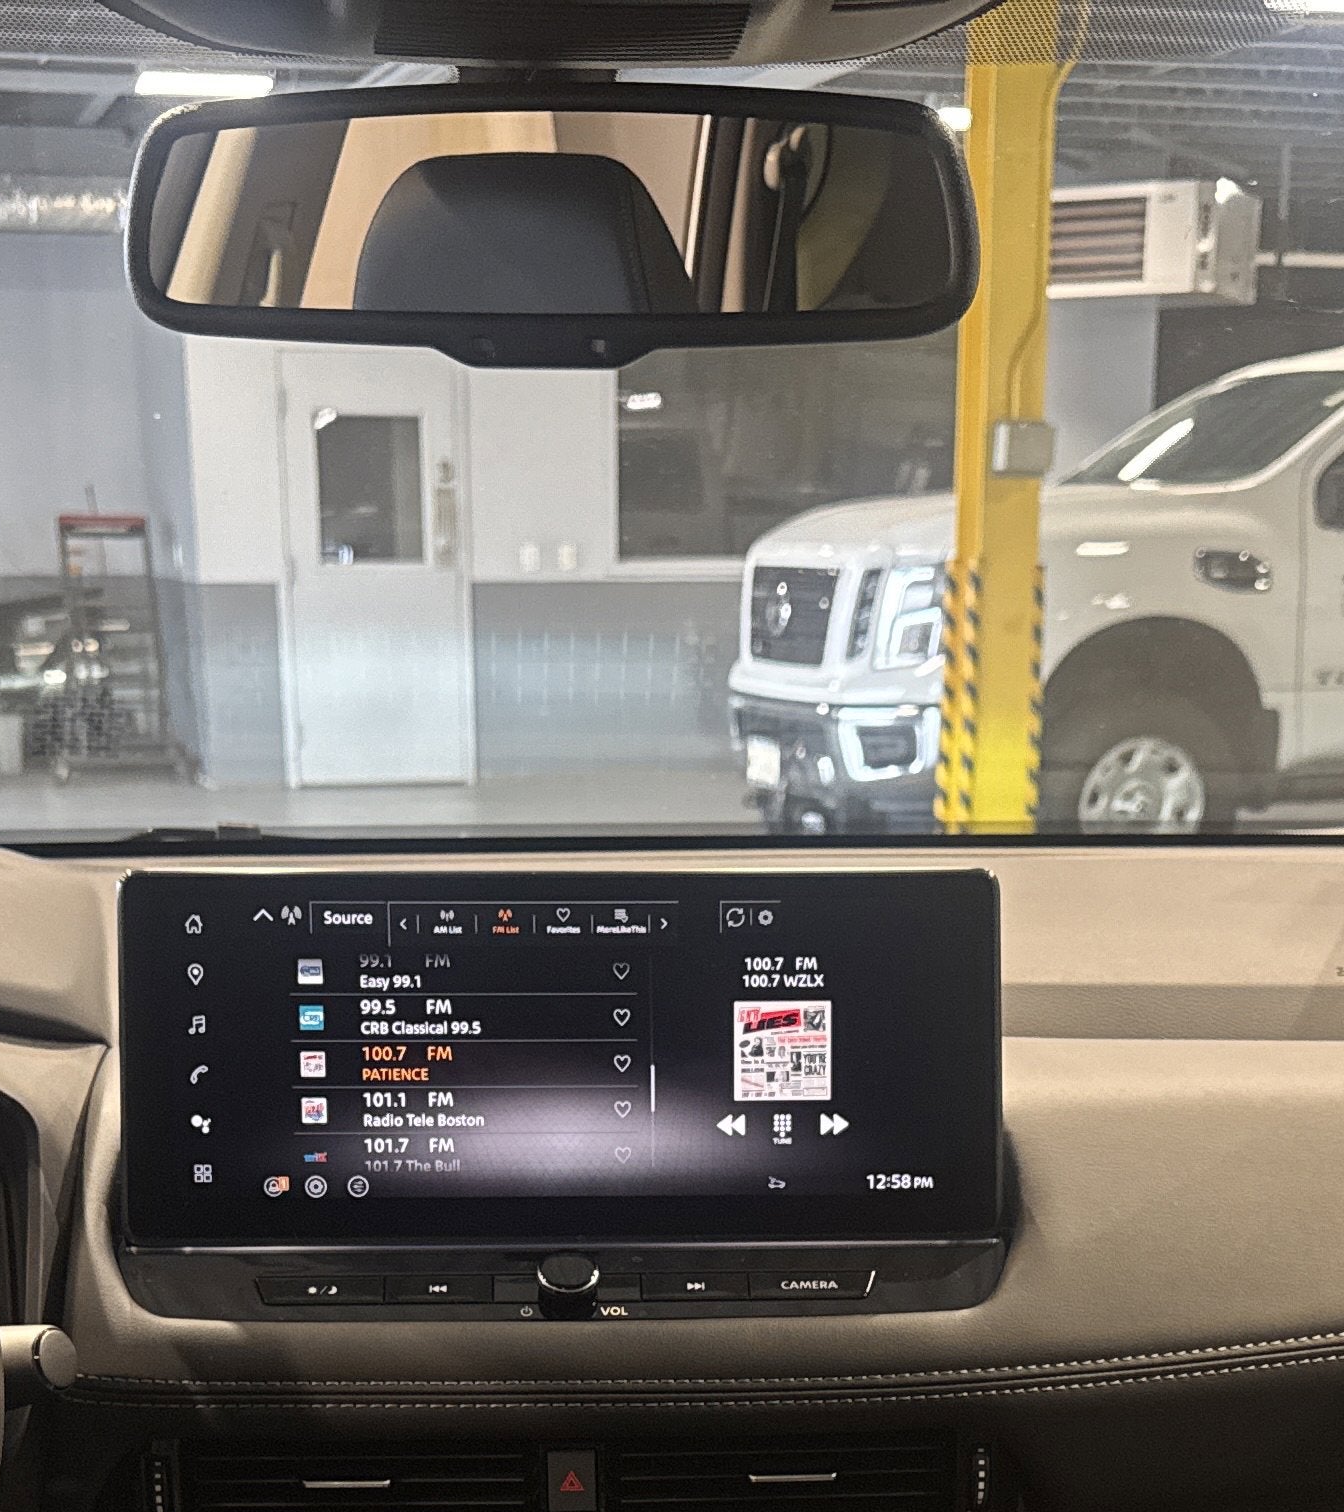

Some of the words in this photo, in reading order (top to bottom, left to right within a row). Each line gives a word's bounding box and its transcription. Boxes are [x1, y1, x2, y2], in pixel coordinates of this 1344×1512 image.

[323, 910, 373, 926] Source
[546, 925, 581, 934] Favorites
[425, 953, 451, 968] FM
[744, 957, 784, 971] 100.7
[795, 957, 818, 970] FM
[360, 975, 390, 991] Easy
[393, 975, 422, 989] 99.1
[742, 974, 781, 988] 100.7
[783, 974, 825, 988] WZLX
[360, 999, 396, 1016] 99.5
[426, 999, 452, 1015] FM
[360, 1021, 389, 1035] CRB
[391, 1020, 448, 1035] Classical
[450, 1021, 482, 1036] 99.5
[362, 1046, 407, 1063] 100.7
[427, 1046, 453, 1062] FM
[362, 1067, 430, 1082] PATIENCE
[363, 1092, 407, 1108] 101.1
[428, 1092, 454, 1108] FM
[363, 1113, 403, 1128] Radio
[406, 1113, 434, 1128] Tele
[437, 1113, 485, 1128] Boston
[364, 1138, 409, 1154] 101.7
[429, 1138, 455, 1154] FM
[406, 1159, 432, 1173] The
[435, 1159, 461, 1173] Bull
[866, 1173, 912, 1190] 12:58
[913, 1176, 934, 1189] PM
[780, 1278, 838, 1291] CAMERA
[600, 1306, 629, 1317] VOL
